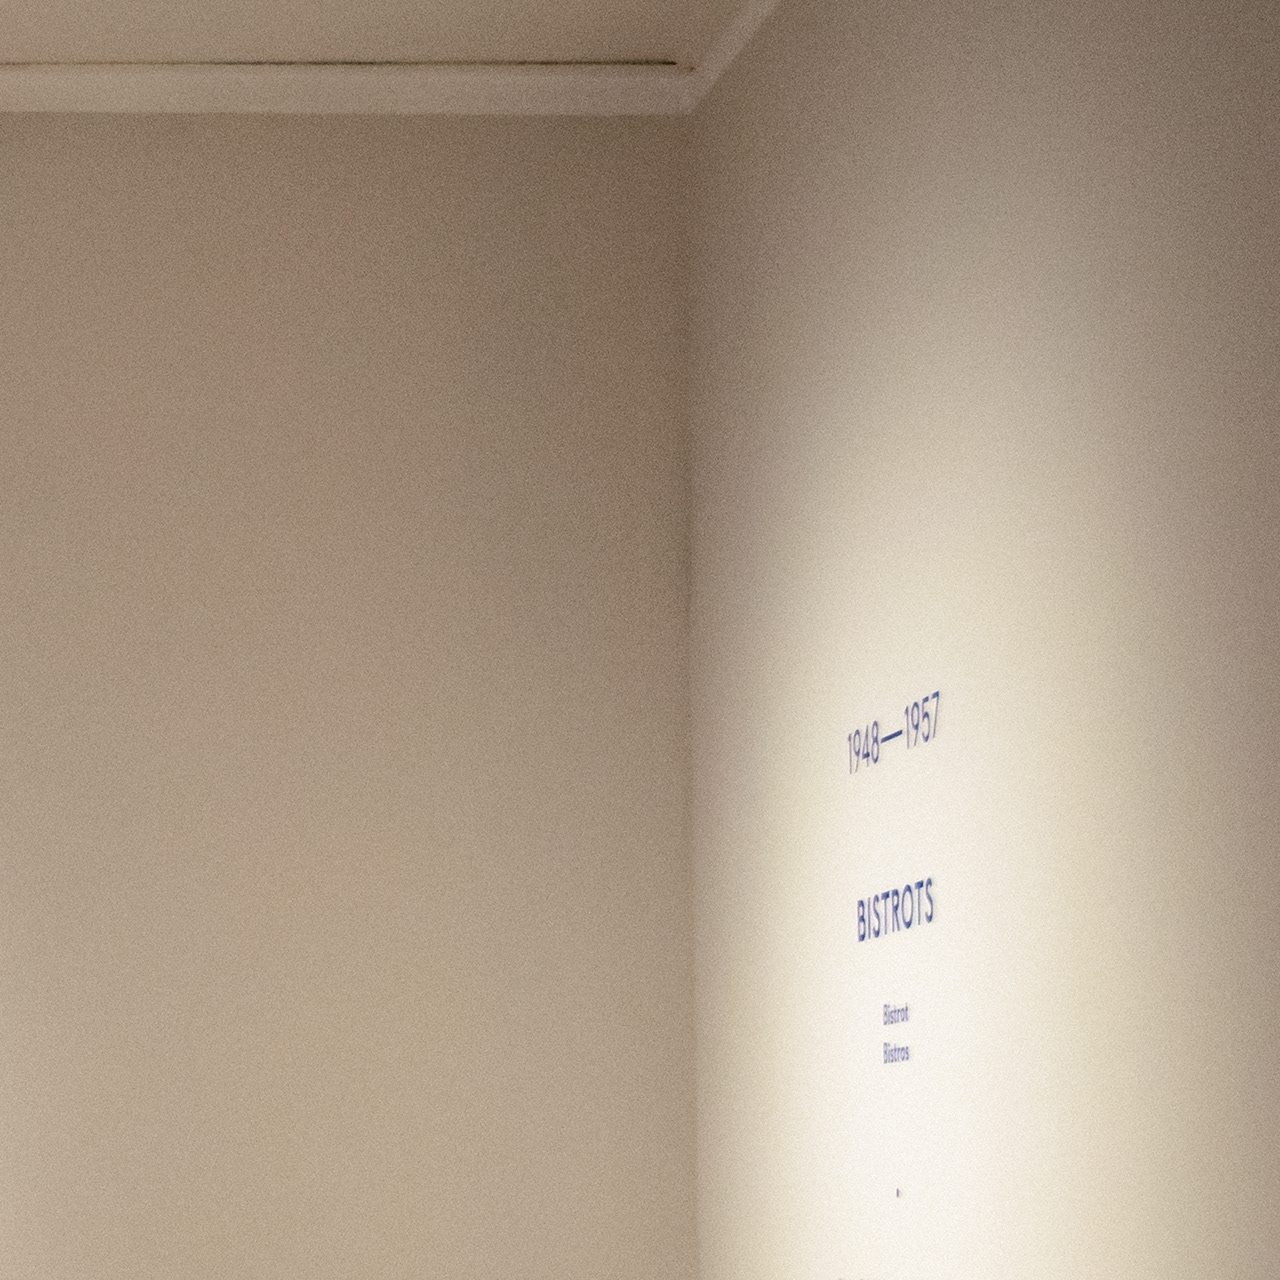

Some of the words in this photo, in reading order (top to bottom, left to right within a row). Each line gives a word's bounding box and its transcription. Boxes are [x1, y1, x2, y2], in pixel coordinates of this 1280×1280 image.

[857, 878, 934, 942] BISTROTS
[883, 1002, 909, 1025] Bistrot
[883, 1042, 910, 1064] Bistros
